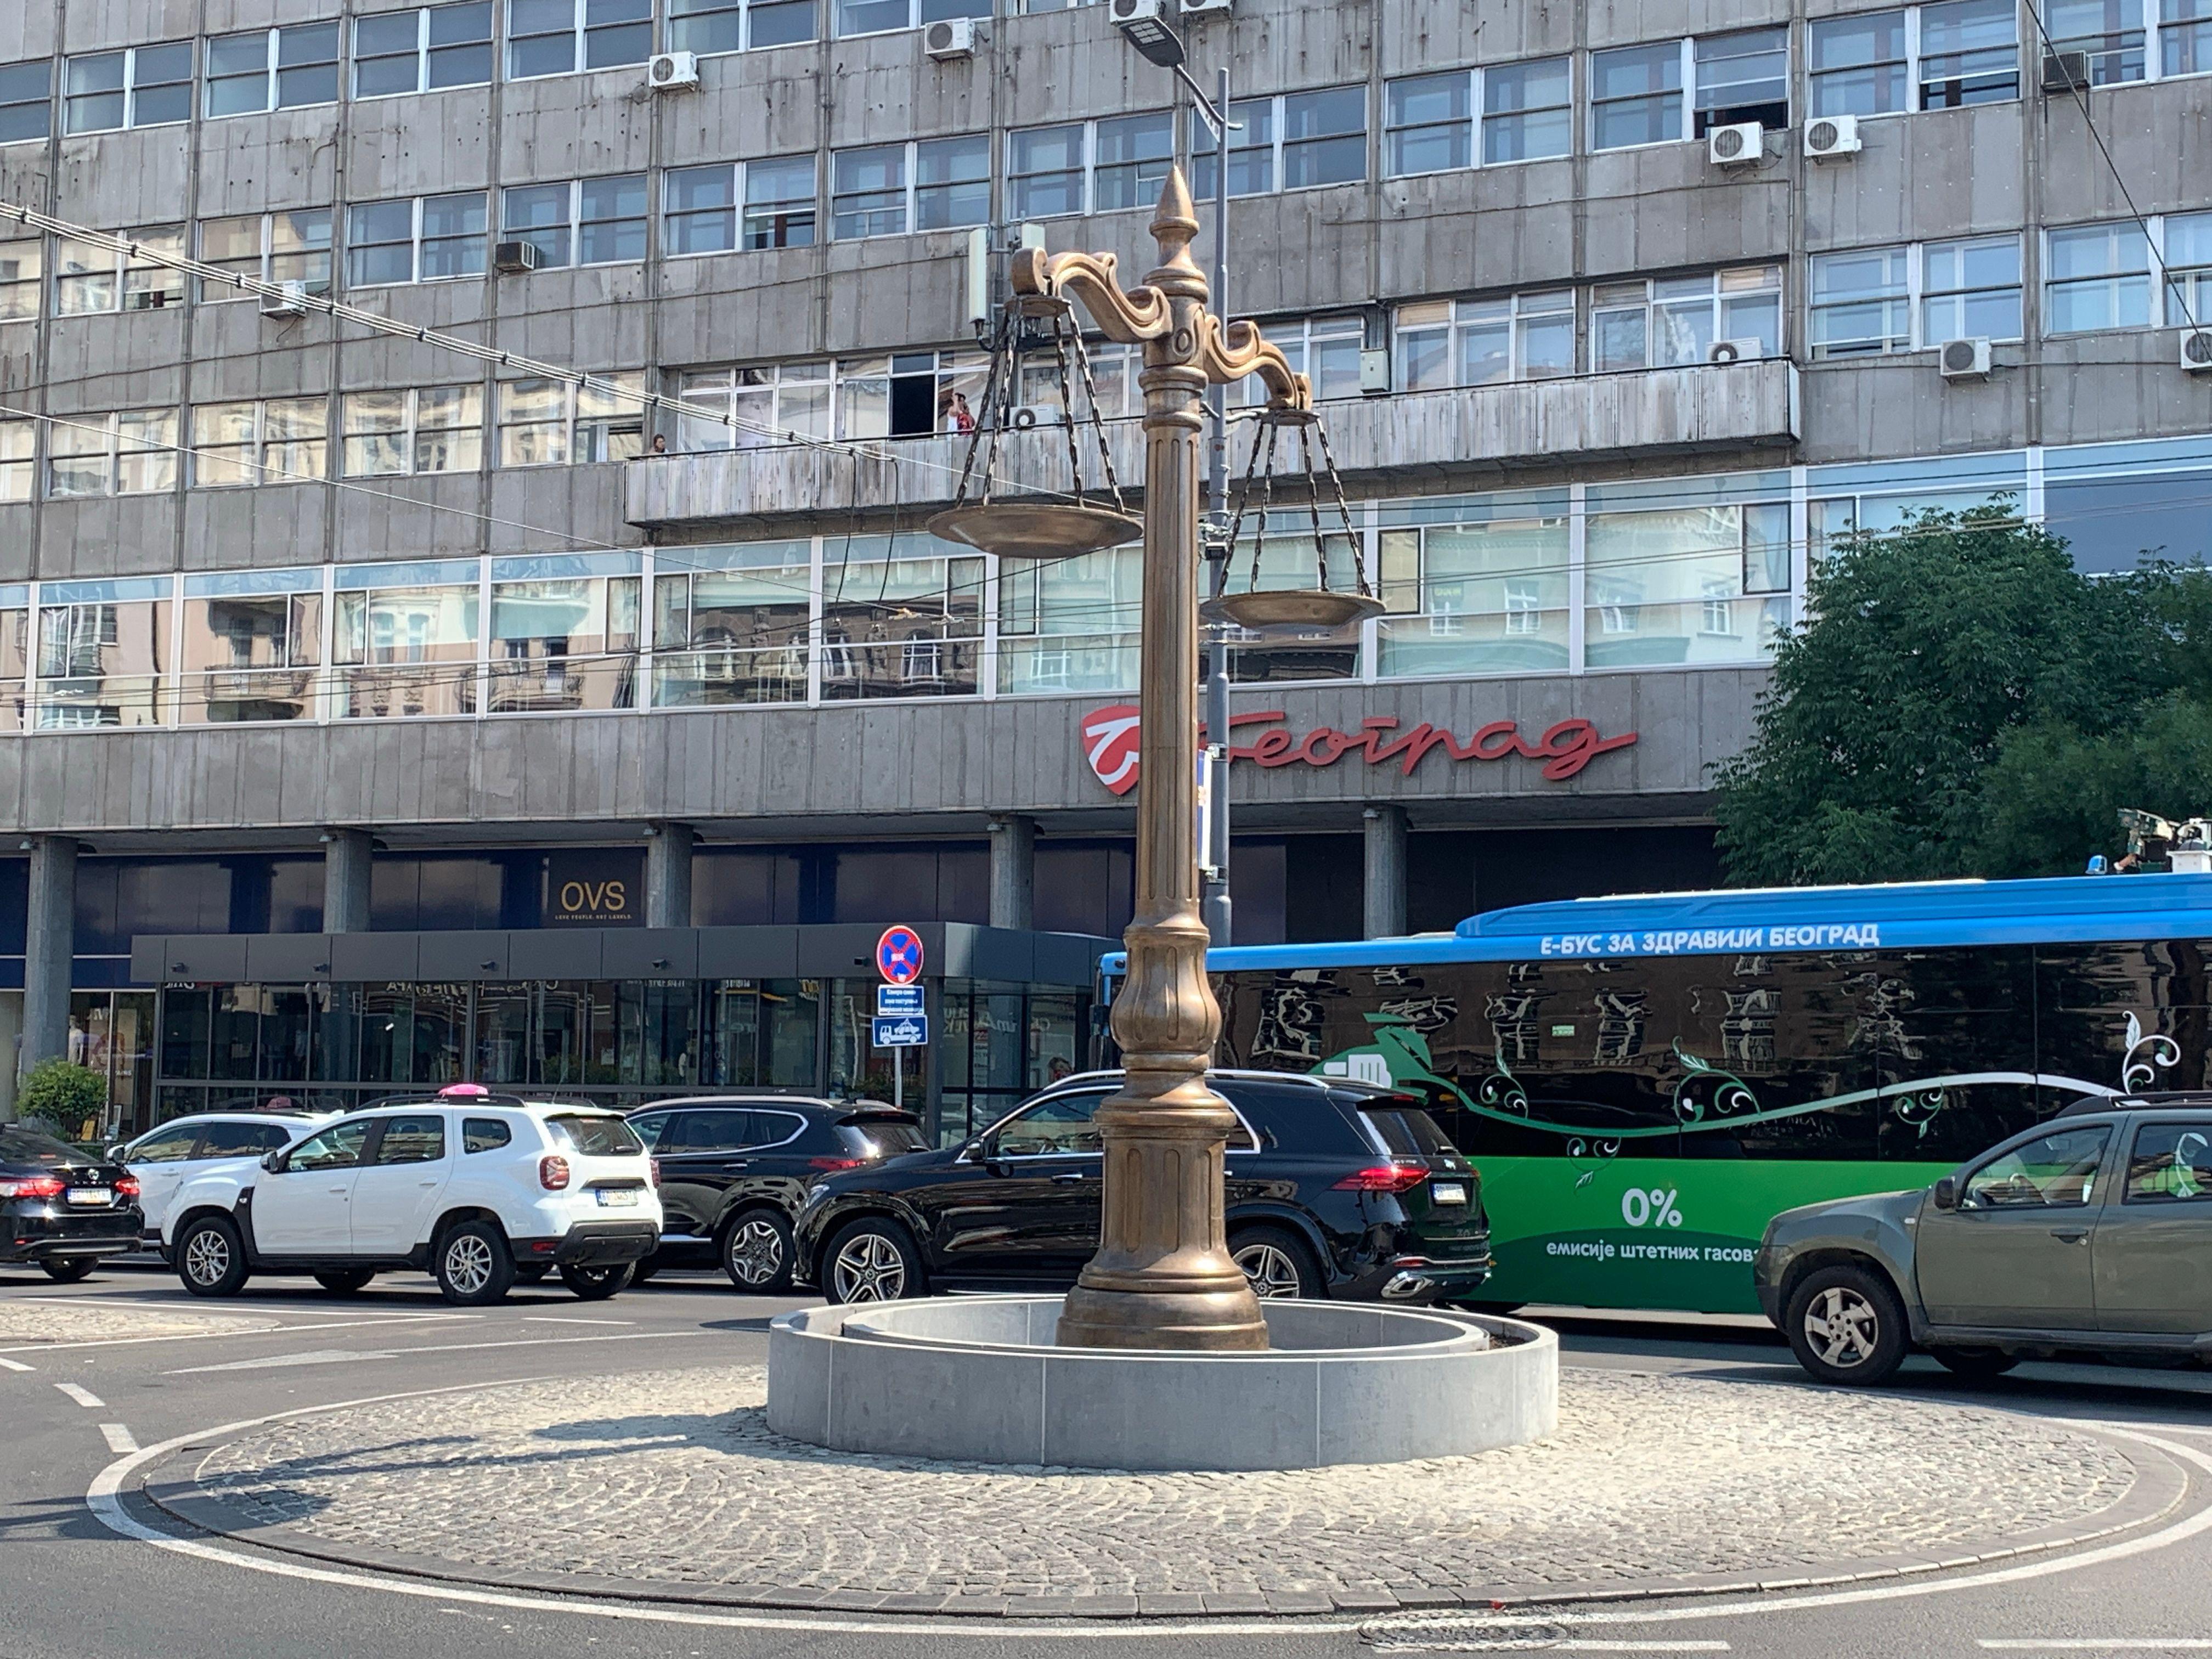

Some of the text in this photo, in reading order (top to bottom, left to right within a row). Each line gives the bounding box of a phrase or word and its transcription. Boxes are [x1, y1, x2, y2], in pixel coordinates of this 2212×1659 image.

[561, 881, 625, 912] OVS
[1541, 924, 1880, 955] Е-БУС ЗА ЗДРАВИЈИ БЕОГРАД
[1622, 1188, 1683, 1227] 0%
[1547, 1239, 1615, 1262] емисије
[1621, 1245, 1700, 1260] штетних
